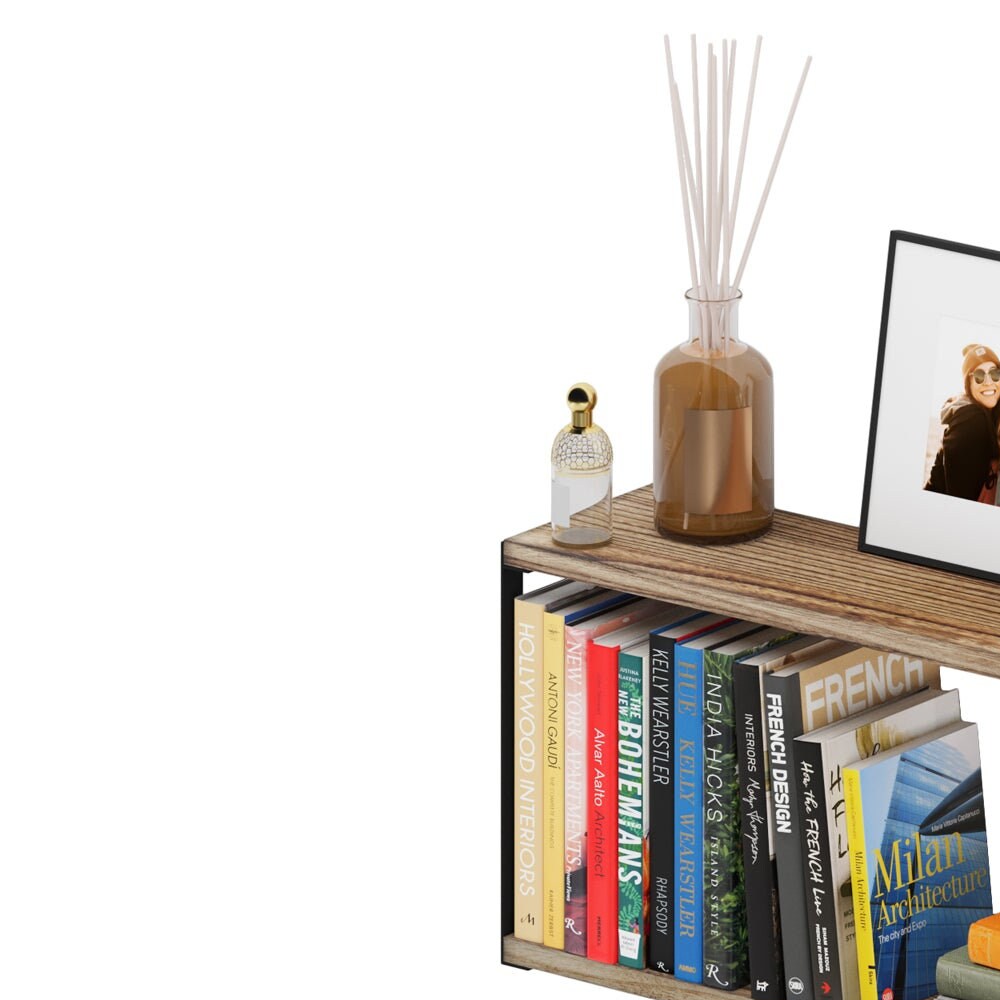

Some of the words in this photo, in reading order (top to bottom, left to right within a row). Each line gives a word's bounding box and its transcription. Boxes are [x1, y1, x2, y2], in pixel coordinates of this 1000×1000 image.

[566, 640, 583, 682] NEW
[652, 648, 670, 693] KELLY
[677, 661, 697, 717] HUE
[518, 622, 536, 773] HOLLYWOOD
[547, 672, 558, 723] ANTONI
[566, 692, 583, 738] YORK
[618, 690, 629, 720] NEW
[629, 697, 641, 719] THE
[706, 673, 722, 737] INDIA
[805, 653, 925, 732] FRENCH
[593, 727, 606, 766] Alvar
[652, 696, 670, 785] WEARSTLER
[744, 713, 757, 772] INTERIORS
[766, 693, 787, 765] FRENCH
[593, 767, 606, 807] Aalto
[679, 737, 696, 808] KELLY
[706, 747, 723, 823] HICKS
[772, 768, 792, 834] DESIGN
[800, 760, 815, 788] How
[566, 745, 583, 866] APARTMENTS
[617, 722, 643, 886] BOHEMIANS
[518, 779, 536, 896] INTERIORS
[594, 810, 605, 877] Architect
[710, 836, 719, 887] ISLAND
[805, 818, 825, 884] FRENCH
[855, 851, 864, 875] Milan
[873, 831, 967, 899] Milan
[656, 876, 668, 935] RHAPSODY
[679, 814, 696, 938] WEARSTLER
[812, 887, 826, 917] Live
[857, 878, 868, 932] Architecture
[877, 866, 987, 931] Architecture
[710, 894, 719, 937] STYLE
[878, 933, 890, 945] The
[890, 928, 901, 940] city
[901, 923, 912, 936] and
[912, 919, 927, 932] Expo
